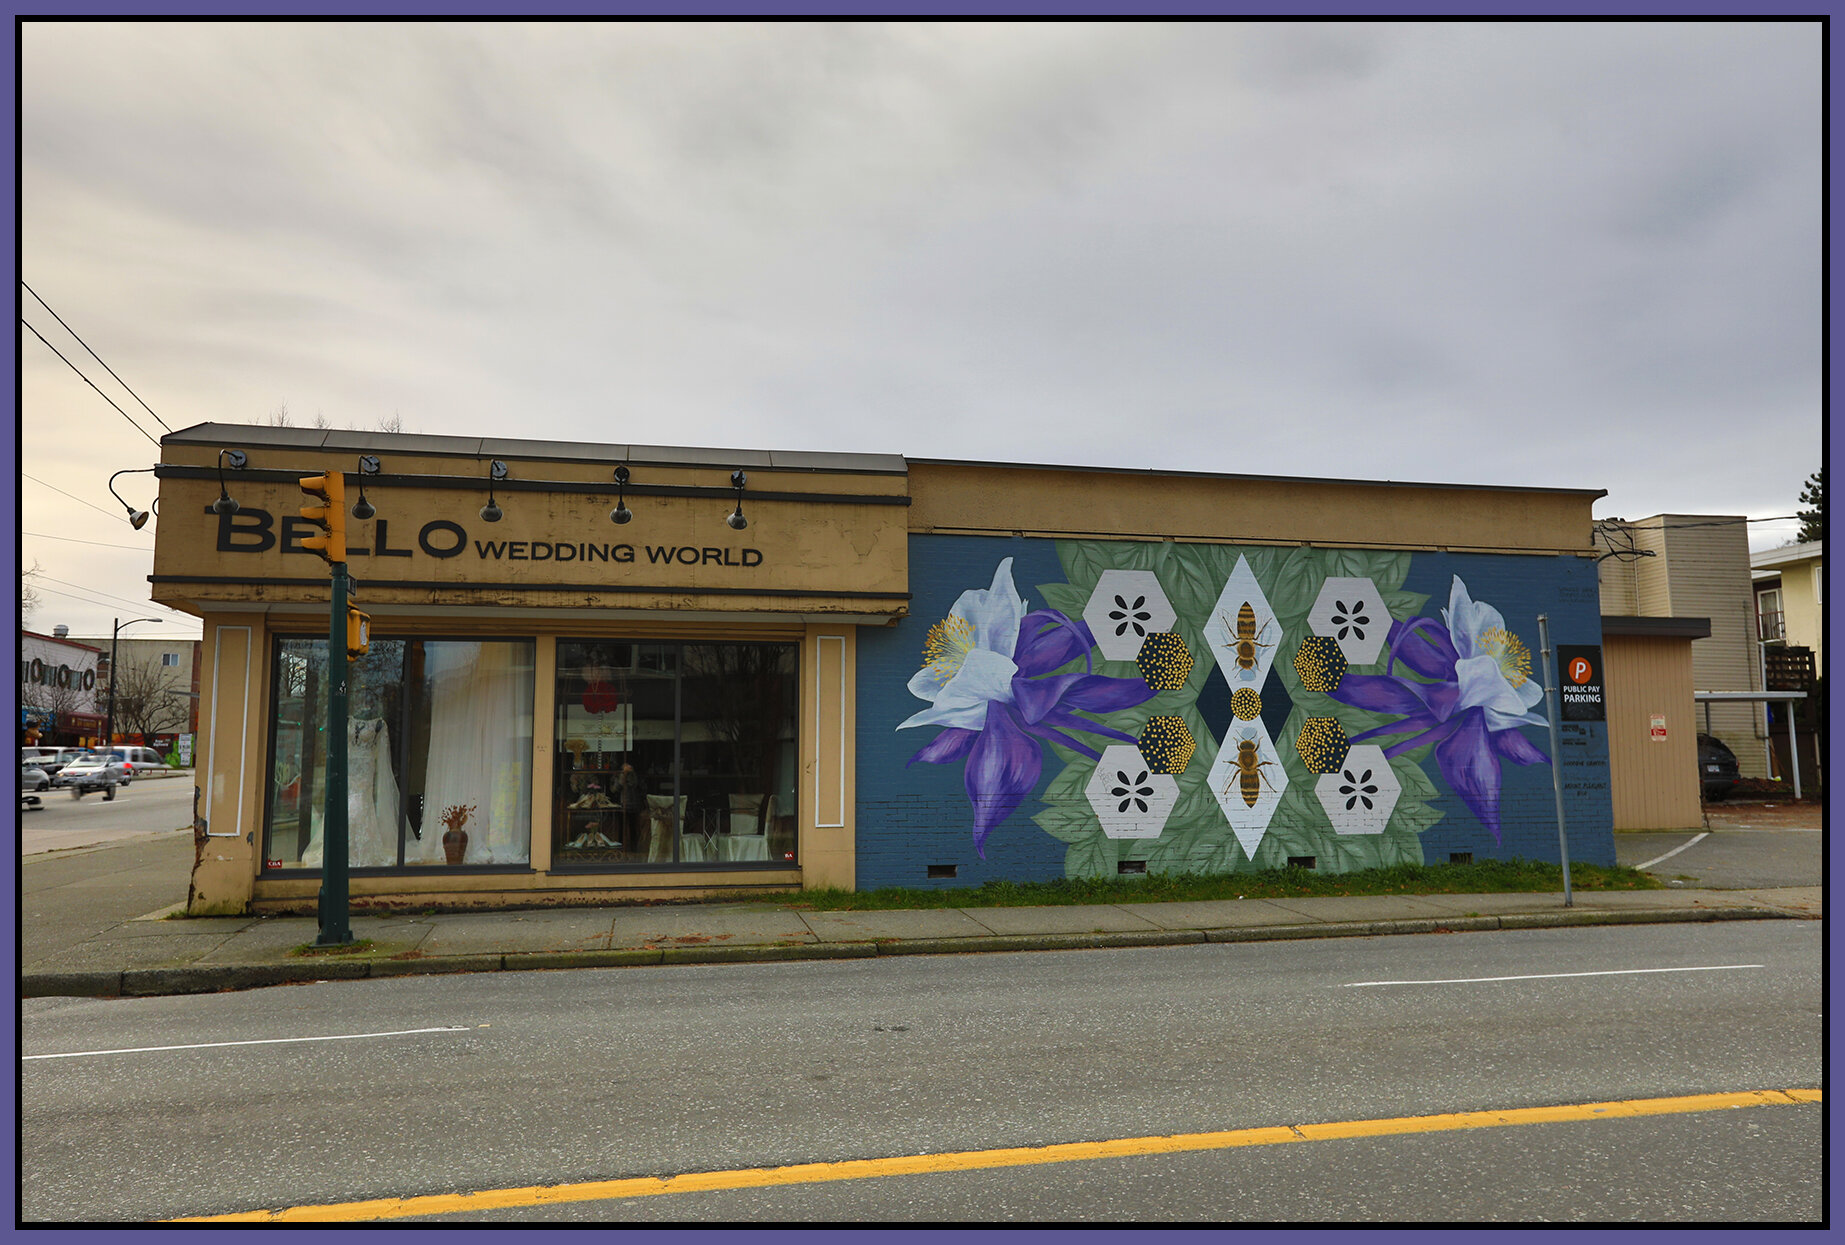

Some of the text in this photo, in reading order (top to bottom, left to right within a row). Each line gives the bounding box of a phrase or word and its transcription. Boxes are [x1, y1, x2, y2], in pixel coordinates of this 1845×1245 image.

[475, 540, 635, 563] WEDDING
[646, 545, 763, 567] WORLD
[1576, 662, 1586, 679] P
[1563, 685, 1600, 693] PUBLIC PAY
[1564, 694, 1601, 703] PARKING
